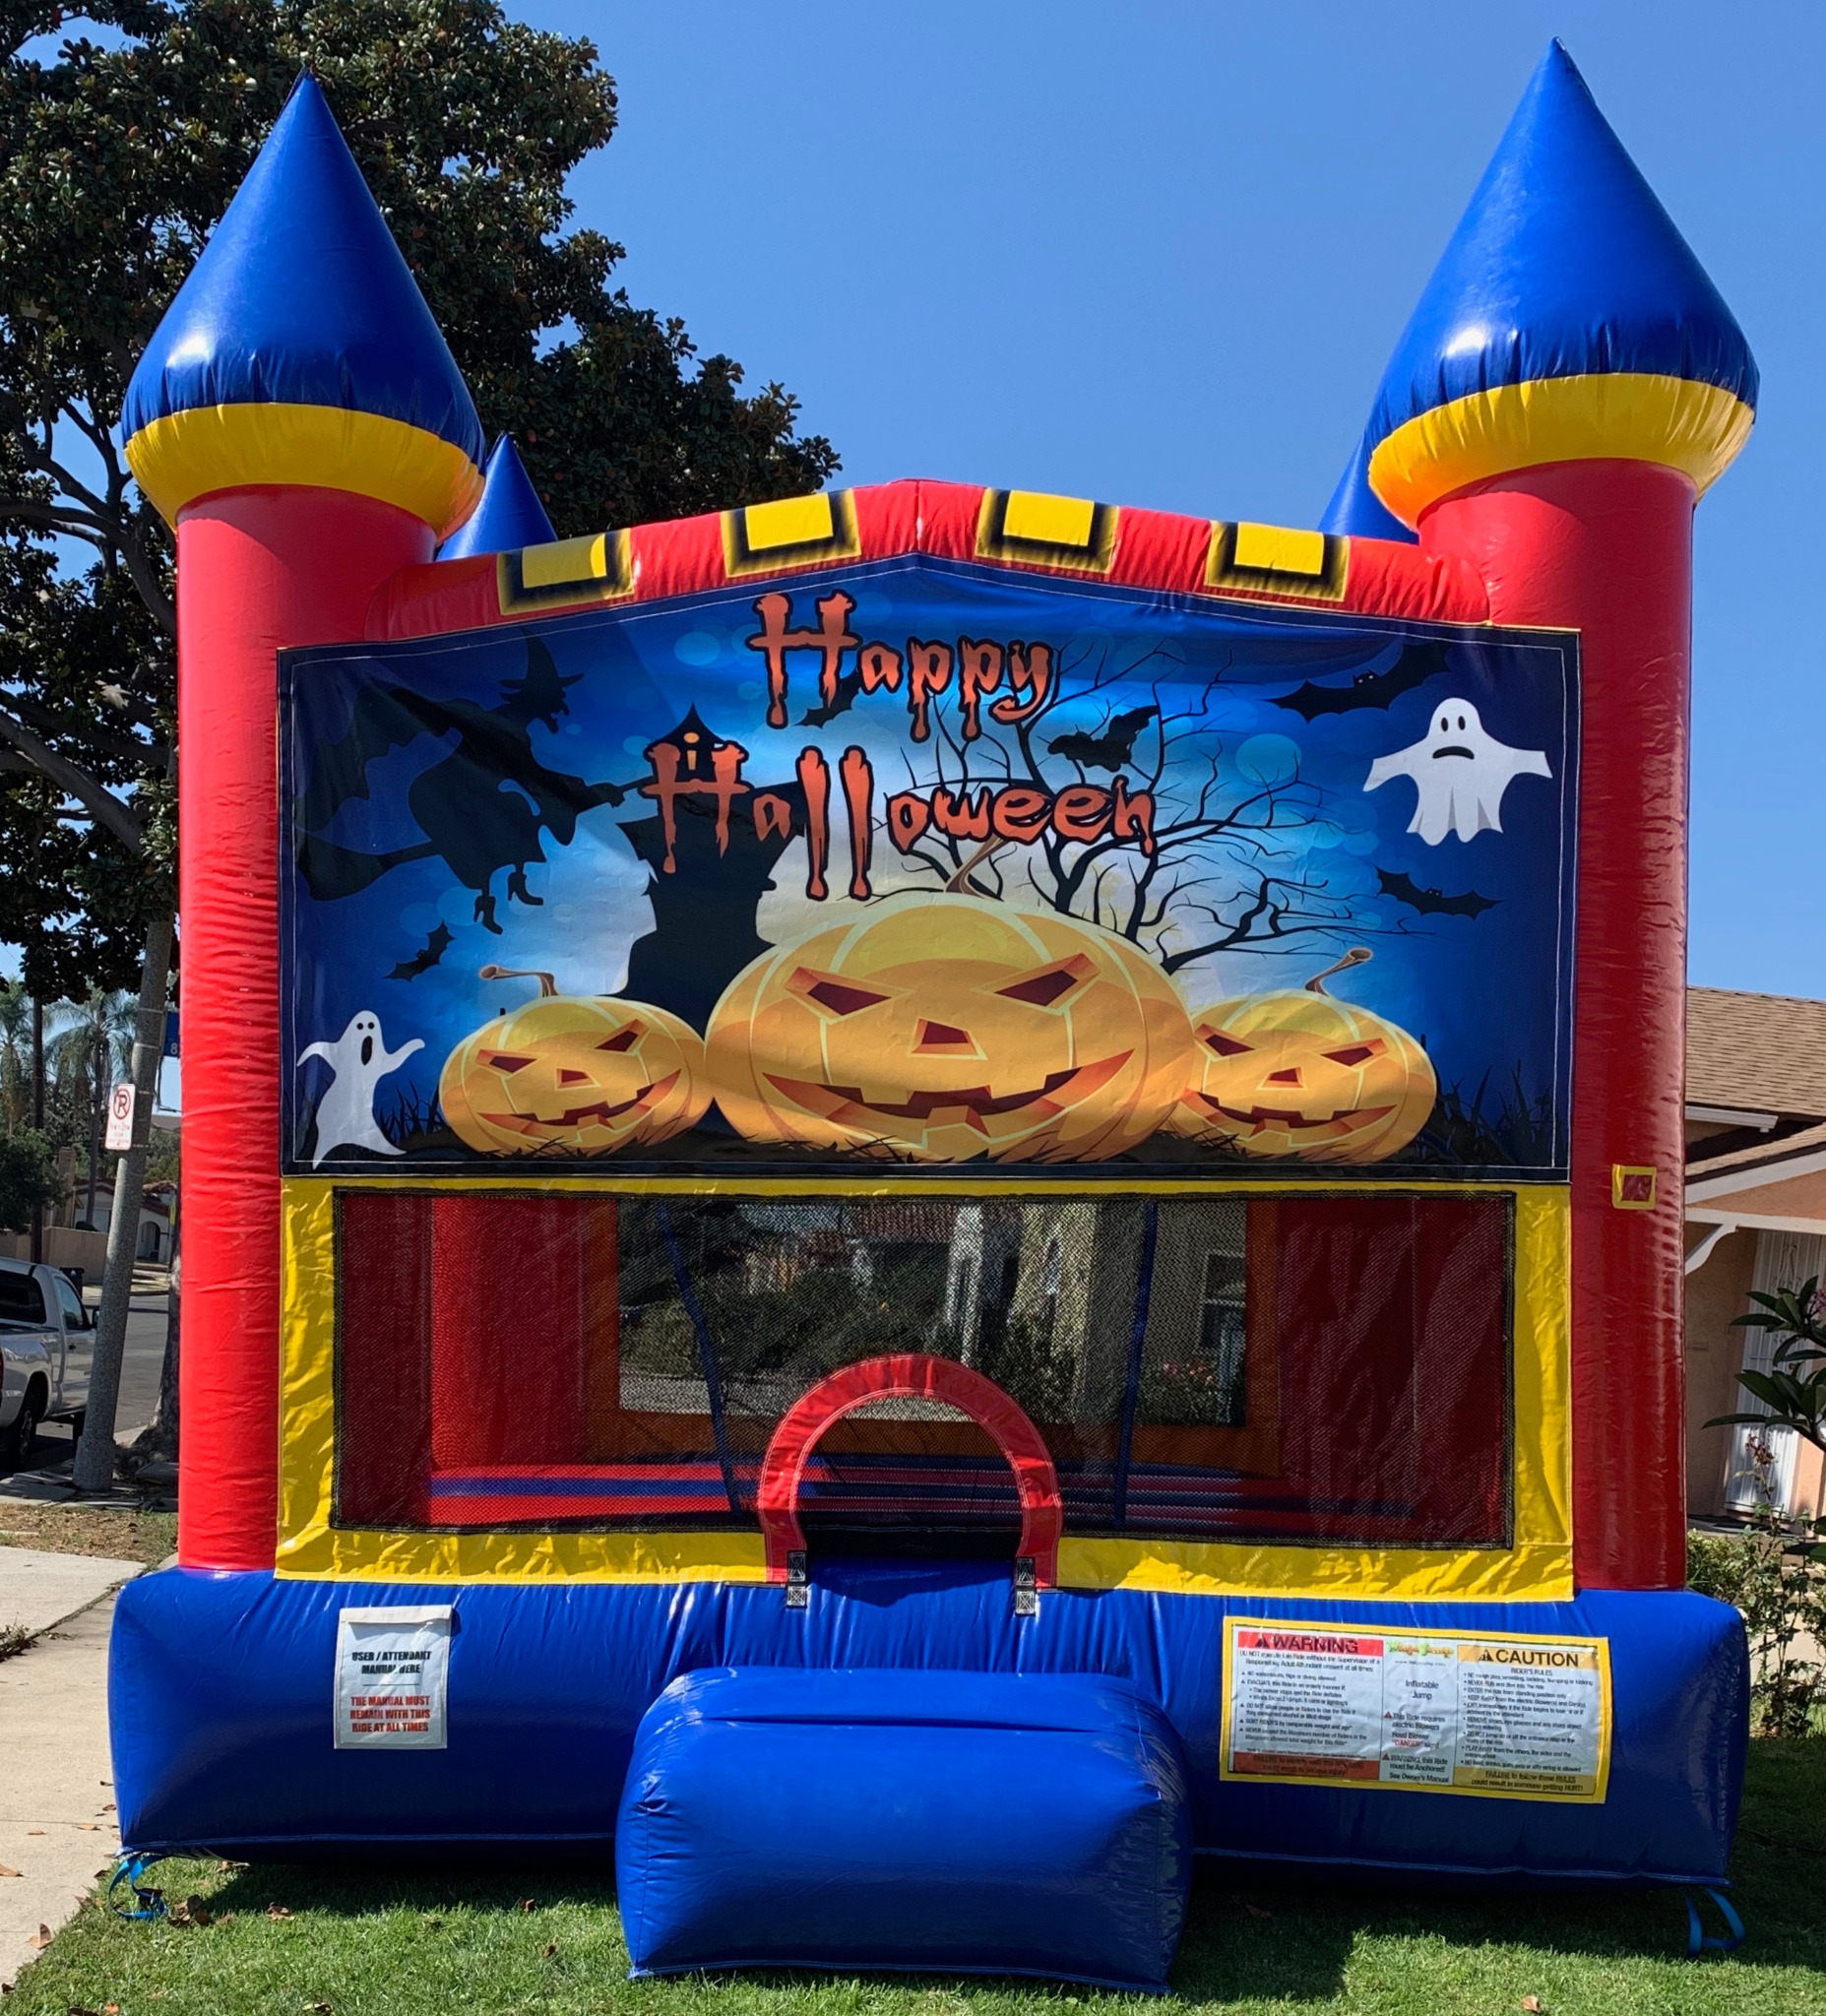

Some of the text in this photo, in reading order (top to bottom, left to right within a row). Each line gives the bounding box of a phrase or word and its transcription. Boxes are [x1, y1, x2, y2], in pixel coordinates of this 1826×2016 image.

[745, 590, 1053, 741] Happy
[638, 745, 1156, 901] Halloween
[1273, 1633, 1358, 1653] WARNING
[352, 1652, 374, 1661] USER
[382, 1651, 431, 1661] ATTENDANT
[1496, 1649, 1579, 1667] CAUTION
[362, 1664, 420, 1673] MANUAL HERE
[1406, 1680, 1438, 1689] Inflatable
[1412, 1690, 1432, 1700] Jump
[368, 1696, 403, 1705] MANUAL
[406, 1696, 430, 1705] MUST
[350, 1709, 430, 1719] REMAIN WITH THIS
[352, 1723, 428, 1732] RIDE AT ALL TIMES
